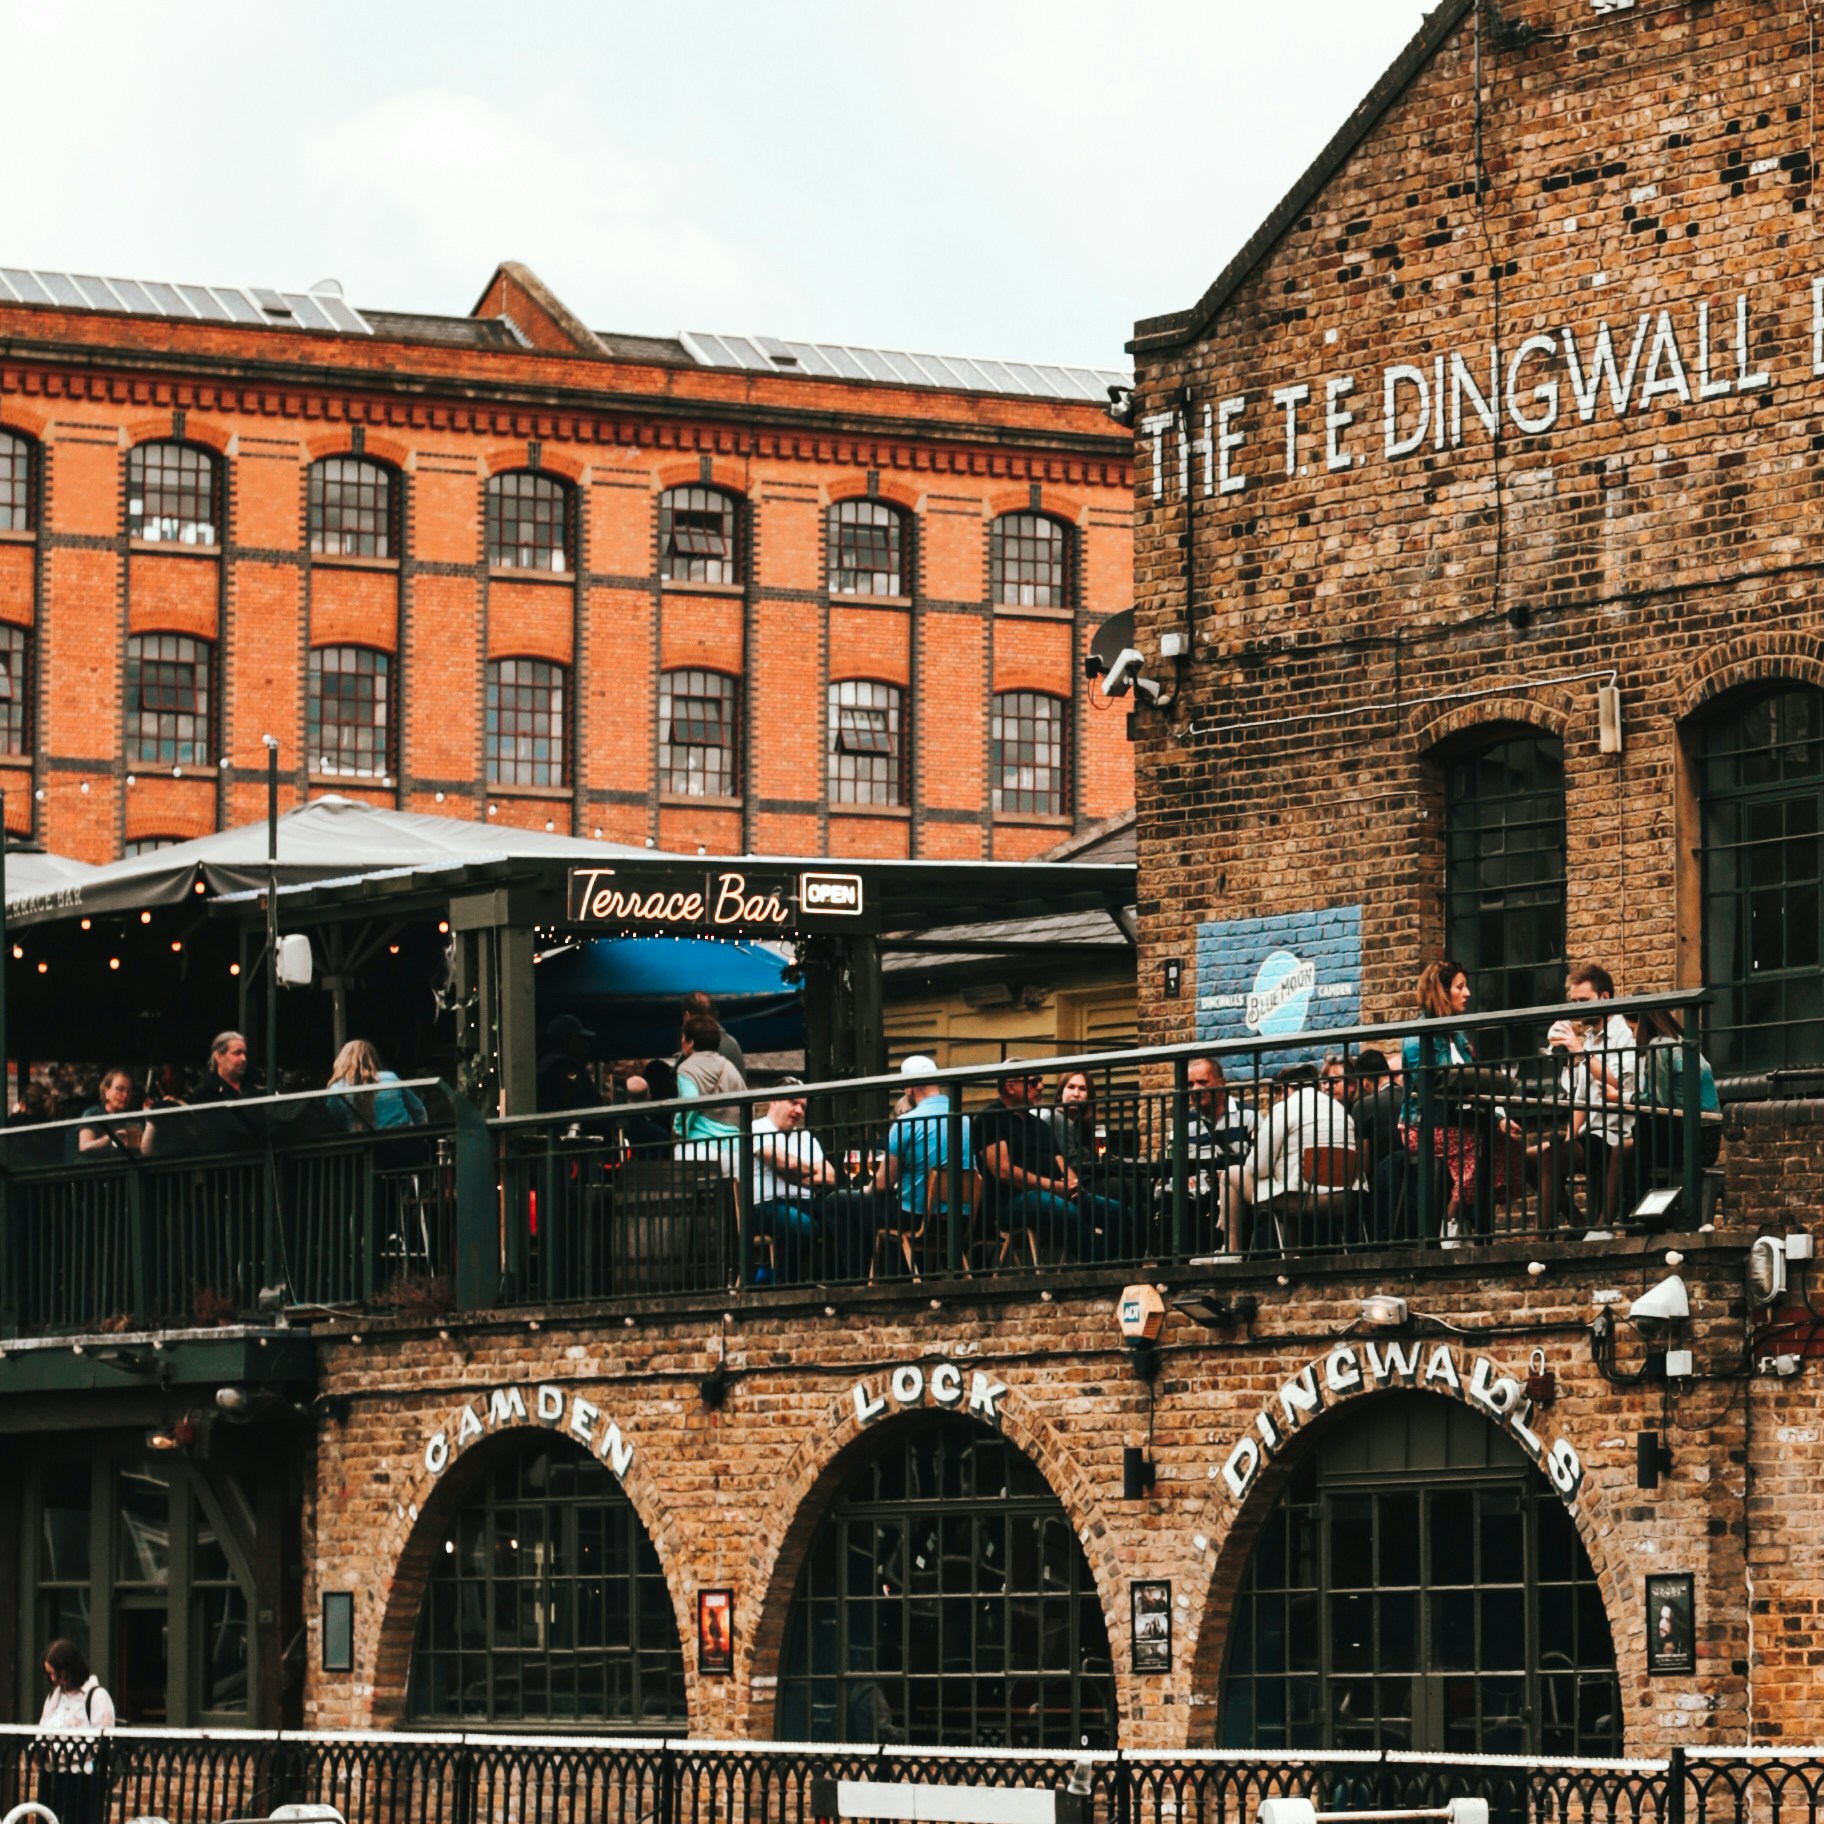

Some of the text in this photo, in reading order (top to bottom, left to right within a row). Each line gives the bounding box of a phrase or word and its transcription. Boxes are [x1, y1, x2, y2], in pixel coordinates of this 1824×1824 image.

[1142, 396, 1246, 500] THE
[1382, 294, 1770, 459] DINGWALL
[573, 869, 788, 924] Terrace Bar
[807, 883, 856, 905] OPEN
[1200, 994, 1245, 1011] DINGWALLS
[1248, 967, 1314, 1024] BLUE MOON
[1318, 983, 1352, 998] CAMDEN
[852, 1363, 1008, 1423] LOCK
[1221, 1341, 1583, 1499] DINGWALLS
[425, 1384, 634, 1478] CAMDEN
